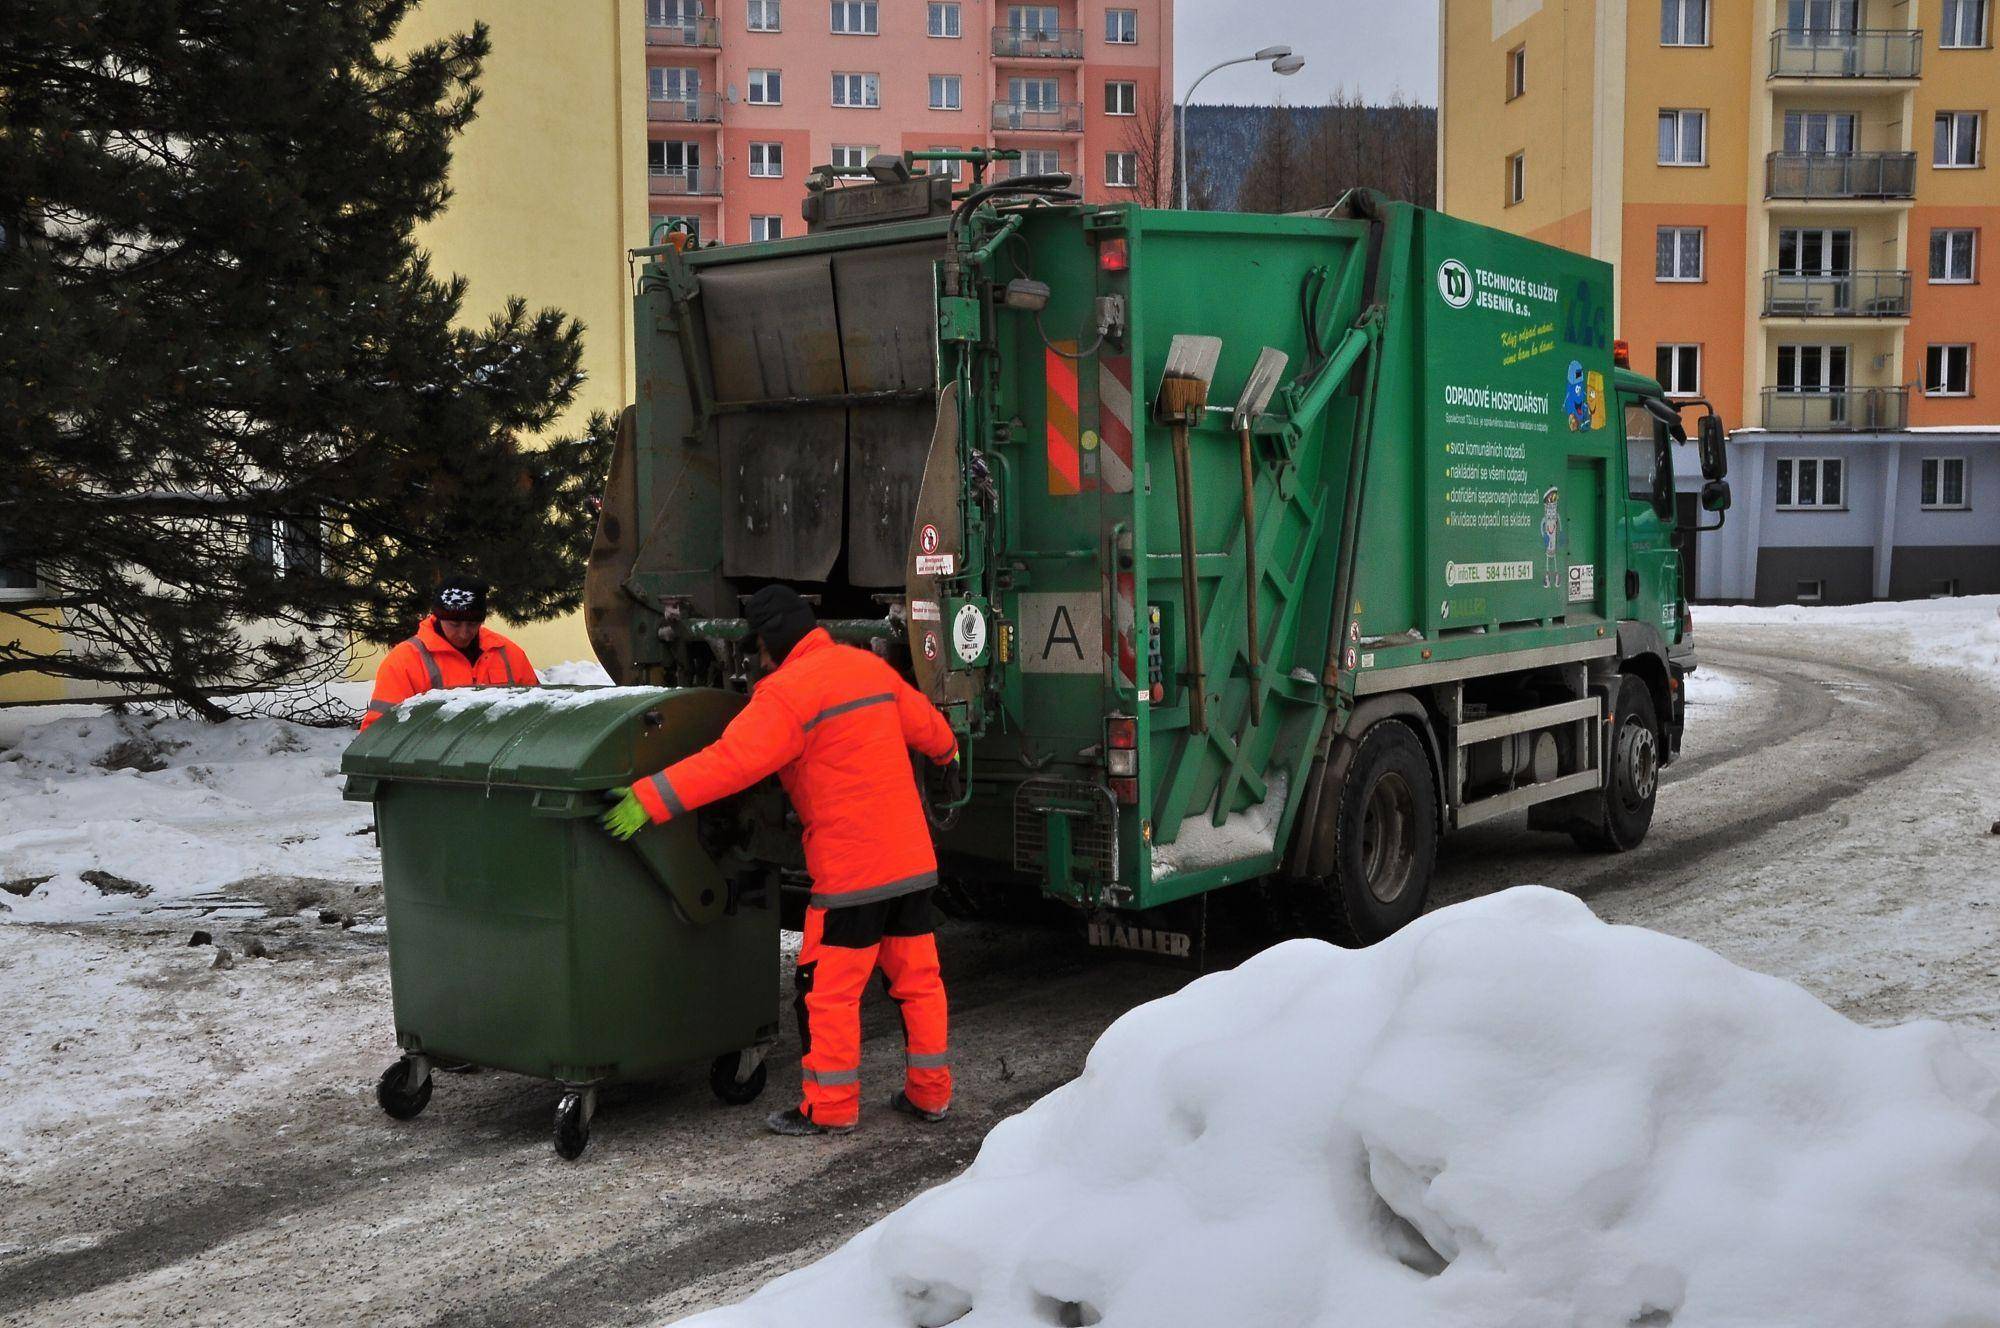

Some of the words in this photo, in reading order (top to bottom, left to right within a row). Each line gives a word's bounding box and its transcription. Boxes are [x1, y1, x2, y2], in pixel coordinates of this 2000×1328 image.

[1475, 268, 1526, 295] TECHNICKÉ
[1527, 282, 1559, 303] SLUŽBY
[1476, 291, 1514, 313] JESENÍK
[1515, 303, 1531, 316] a.s.
[1445, 385, 1490, 408] ODPADOVÉ
[1491, 390, 1548, 414] HOSPODÁŘSTVÍ
[1450, 442, 1465, 455] svoz
[1465, 441, 1503, 458] komunálních
[1503, 443, 1526, 460] odpadů
[1450, 463, 1480, 479] nakládání
[1480, 467, 1488, 480] se
[1488, 465, 1507, 481] všemi
[1507, 466, 1528, 485] odpady
[1519, 489, 1540, 508] odpadů
[1450, 512, 1477, 527] likvidace
[1478, 510, 1501, 530] odpadů
[1501, 515, 1509, 527] na
[1486, 564, 1500, 580] 584
[1503, 563, 1515, 579] 411
[1517, 562, 1531, 578] 541
[1041, 605, 1085, 661] A
